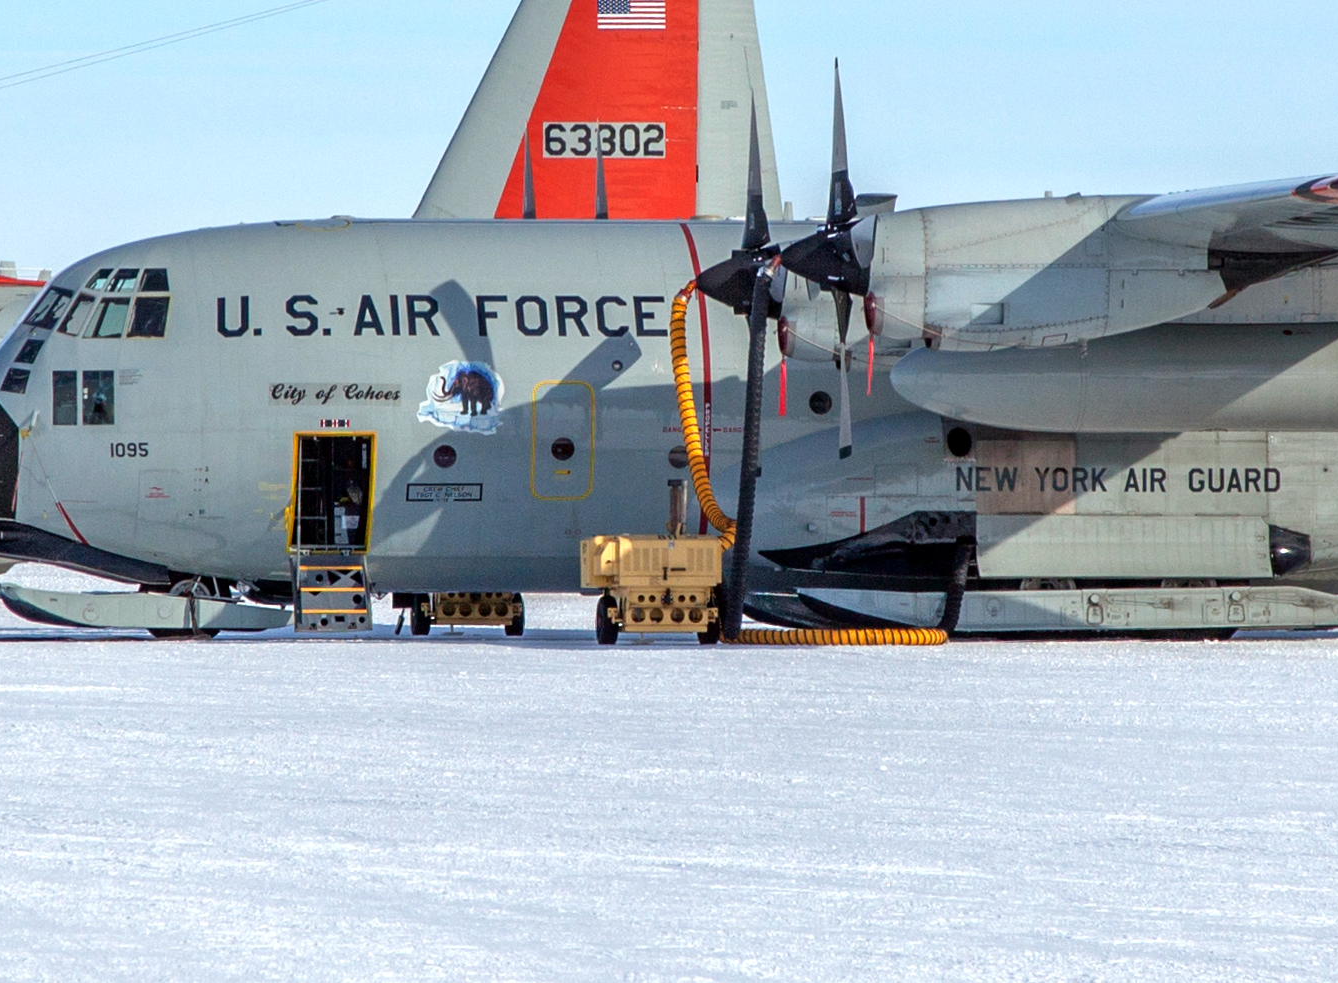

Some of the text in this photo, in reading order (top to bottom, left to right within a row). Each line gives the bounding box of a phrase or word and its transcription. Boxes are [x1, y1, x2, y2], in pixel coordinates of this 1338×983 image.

[544, 123, 664, 157] 63302
[216, 294, 669, 337] U. S. AIR FORCE
[270, 383, 401, 406] City of Cohoes
[110, 442, 149, 458] 1095
[955, 466, 1281, 493] NEW YORK AIR GUARD
